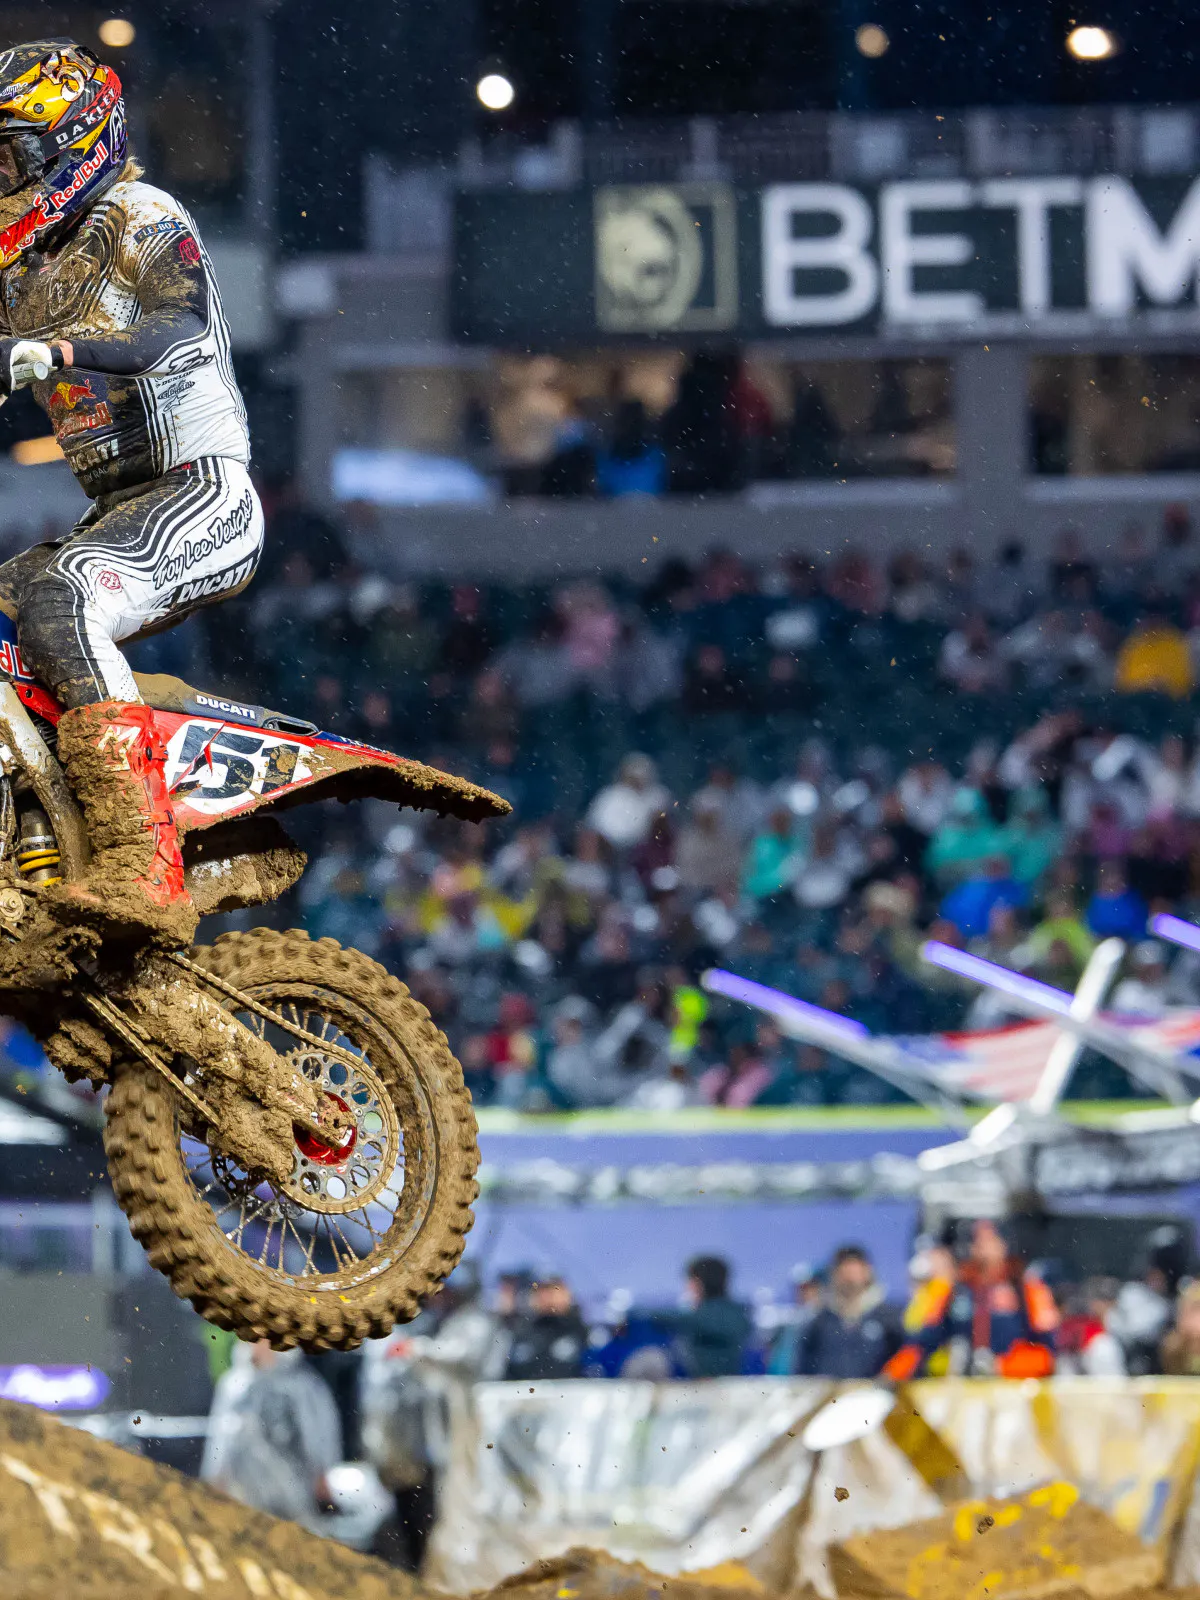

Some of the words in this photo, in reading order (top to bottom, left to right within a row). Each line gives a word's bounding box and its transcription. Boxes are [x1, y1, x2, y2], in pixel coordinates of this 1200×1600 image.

[55, 87, 115, 145] OAKLEY
[49, 169, 86, 210] Red
[79, 140, 109, 182] Bull
[761, 176, 1200, 328] BETM
[153, 555, 186, 590] Troy
[184, 541, 214, 570] Lee
[177, 556, 254, 604] DUCATI
[196, 695, 256, 720] DUCATI
